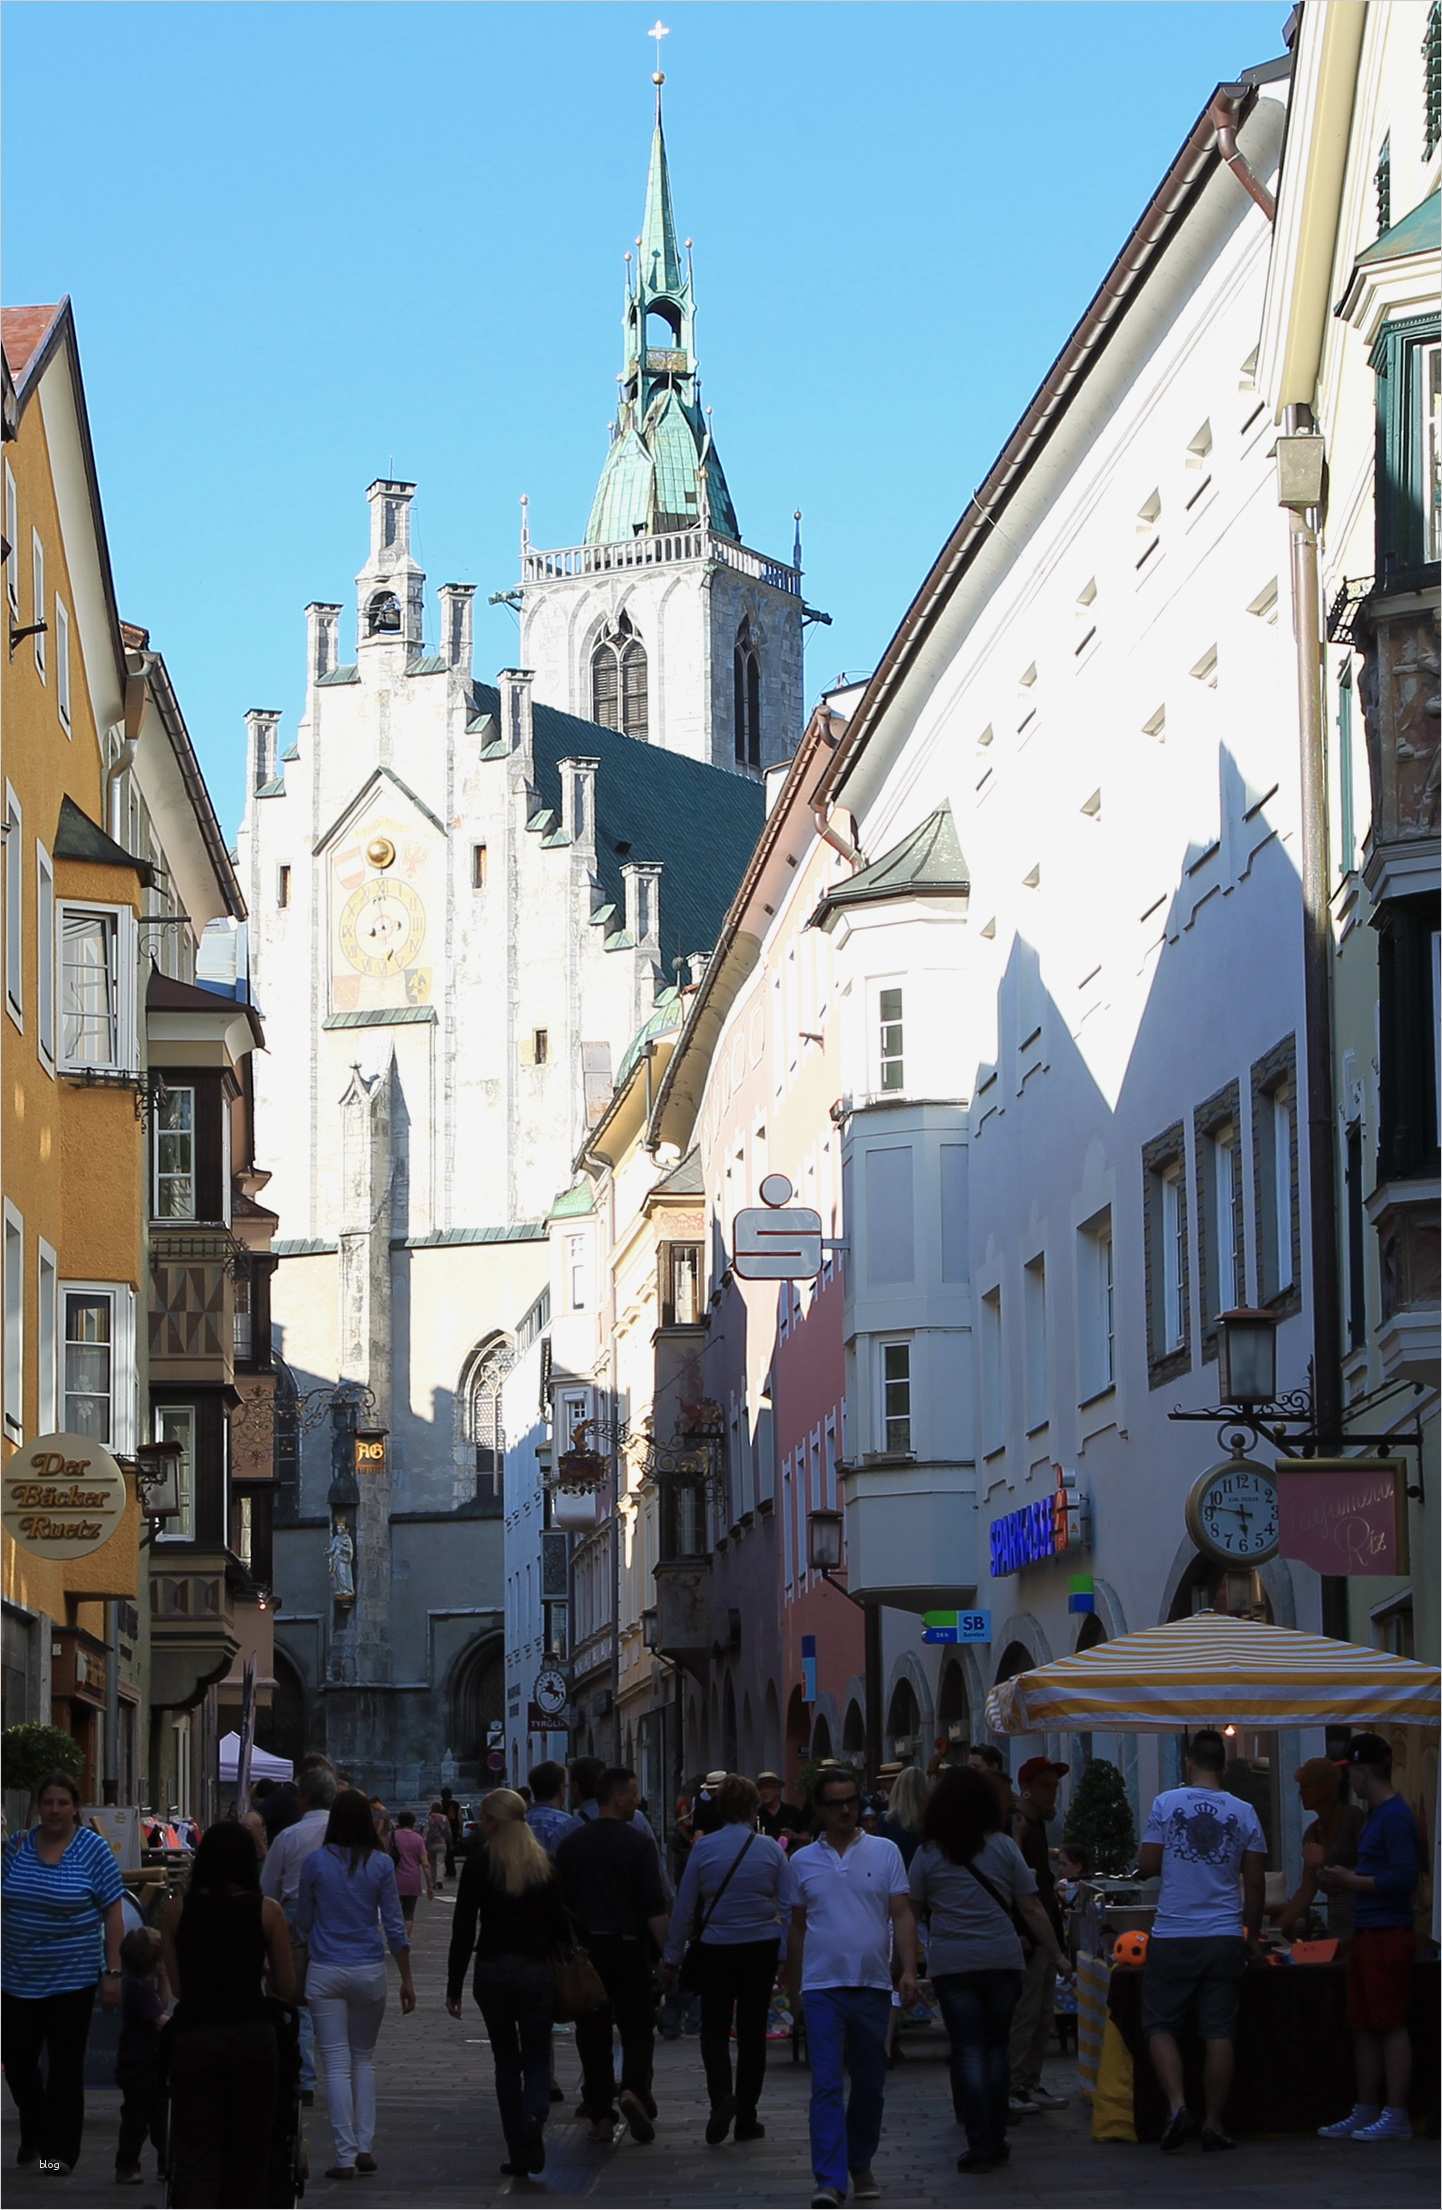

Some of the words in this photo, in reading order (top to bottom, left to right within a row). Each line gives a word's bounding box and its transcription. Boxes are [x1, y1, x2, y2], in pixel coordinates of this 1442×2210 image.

[31, 1452, 91, 1477] Der
[1223, 1479, 1232, 1493] 11
[1236, 1474, 1249, 1488] 12
[1253, 1478, 1259, 1492] 1
[11, 1485, 111, 1508] Bäcker
[1209, 1491, 1223, 1505] 10
[1264, 1488, 1273, 1504] 2
[1204, 1505, 1214, 1521] 9
[1271, 1505, 1280, 1520] 3
[19, 1516, 103, 1540] Ruetz
[1210, 1522, 1219, 1537] 8
[1264, 1521, 1275, 1536] 4
[1224, 1533, 1233, 1548] 7
[1239, 1538, 1248, 1552] 6
[1255, 1532, 1264, 1547] 5
[963, 1616, 984, 1630] SB
